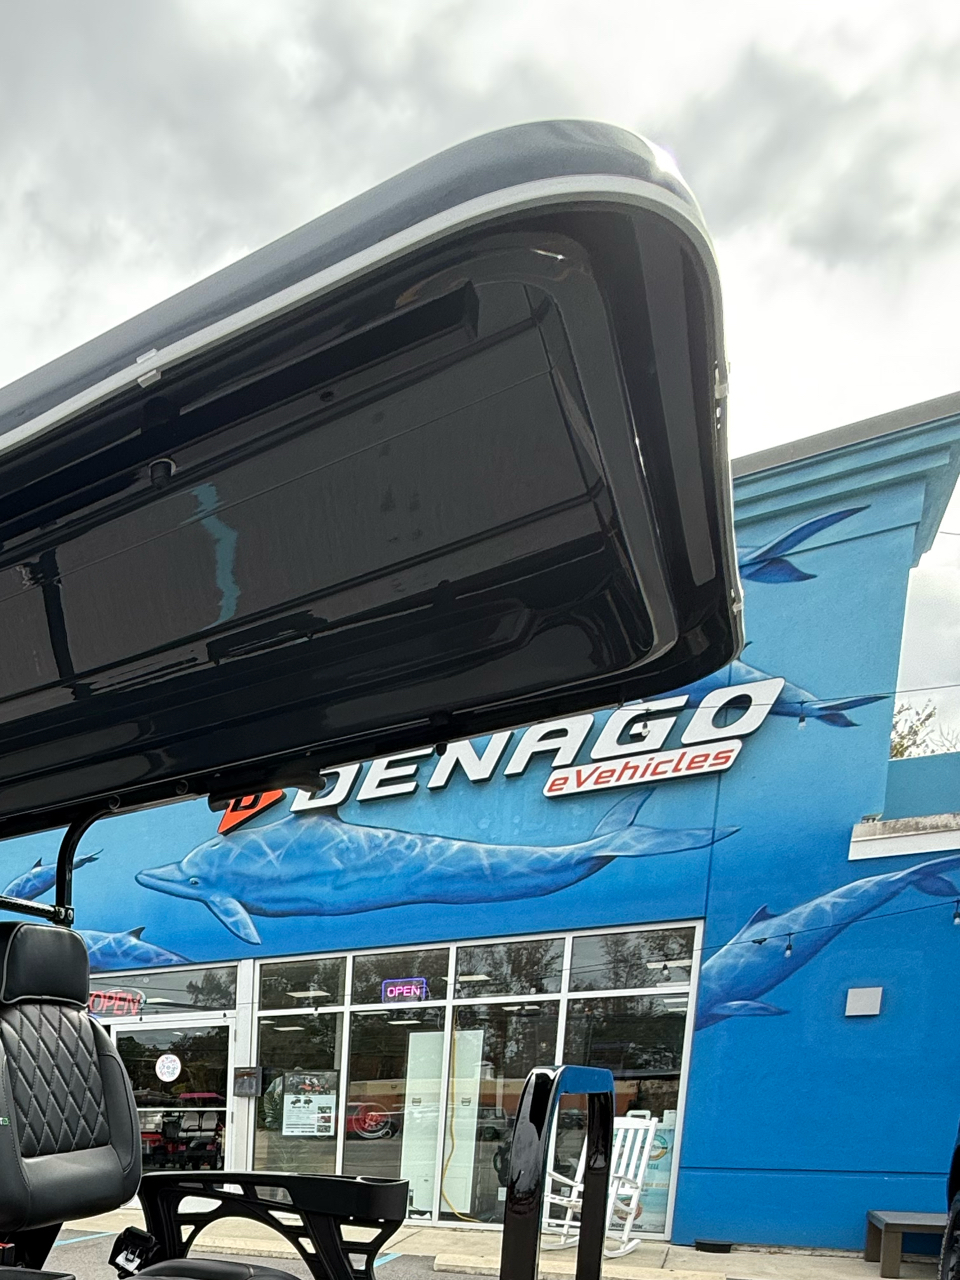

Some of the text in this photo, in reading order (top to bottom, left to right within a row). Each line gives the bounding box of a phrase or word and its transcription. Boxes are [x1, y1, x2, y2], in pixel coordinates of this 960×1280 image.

[289, 677, 786, 812] DENAGO
[546, 748, 736, 794] eVehicles
[88, 989, 143, 1016] OPEN
[386, 984, 421, 998] OPEN
